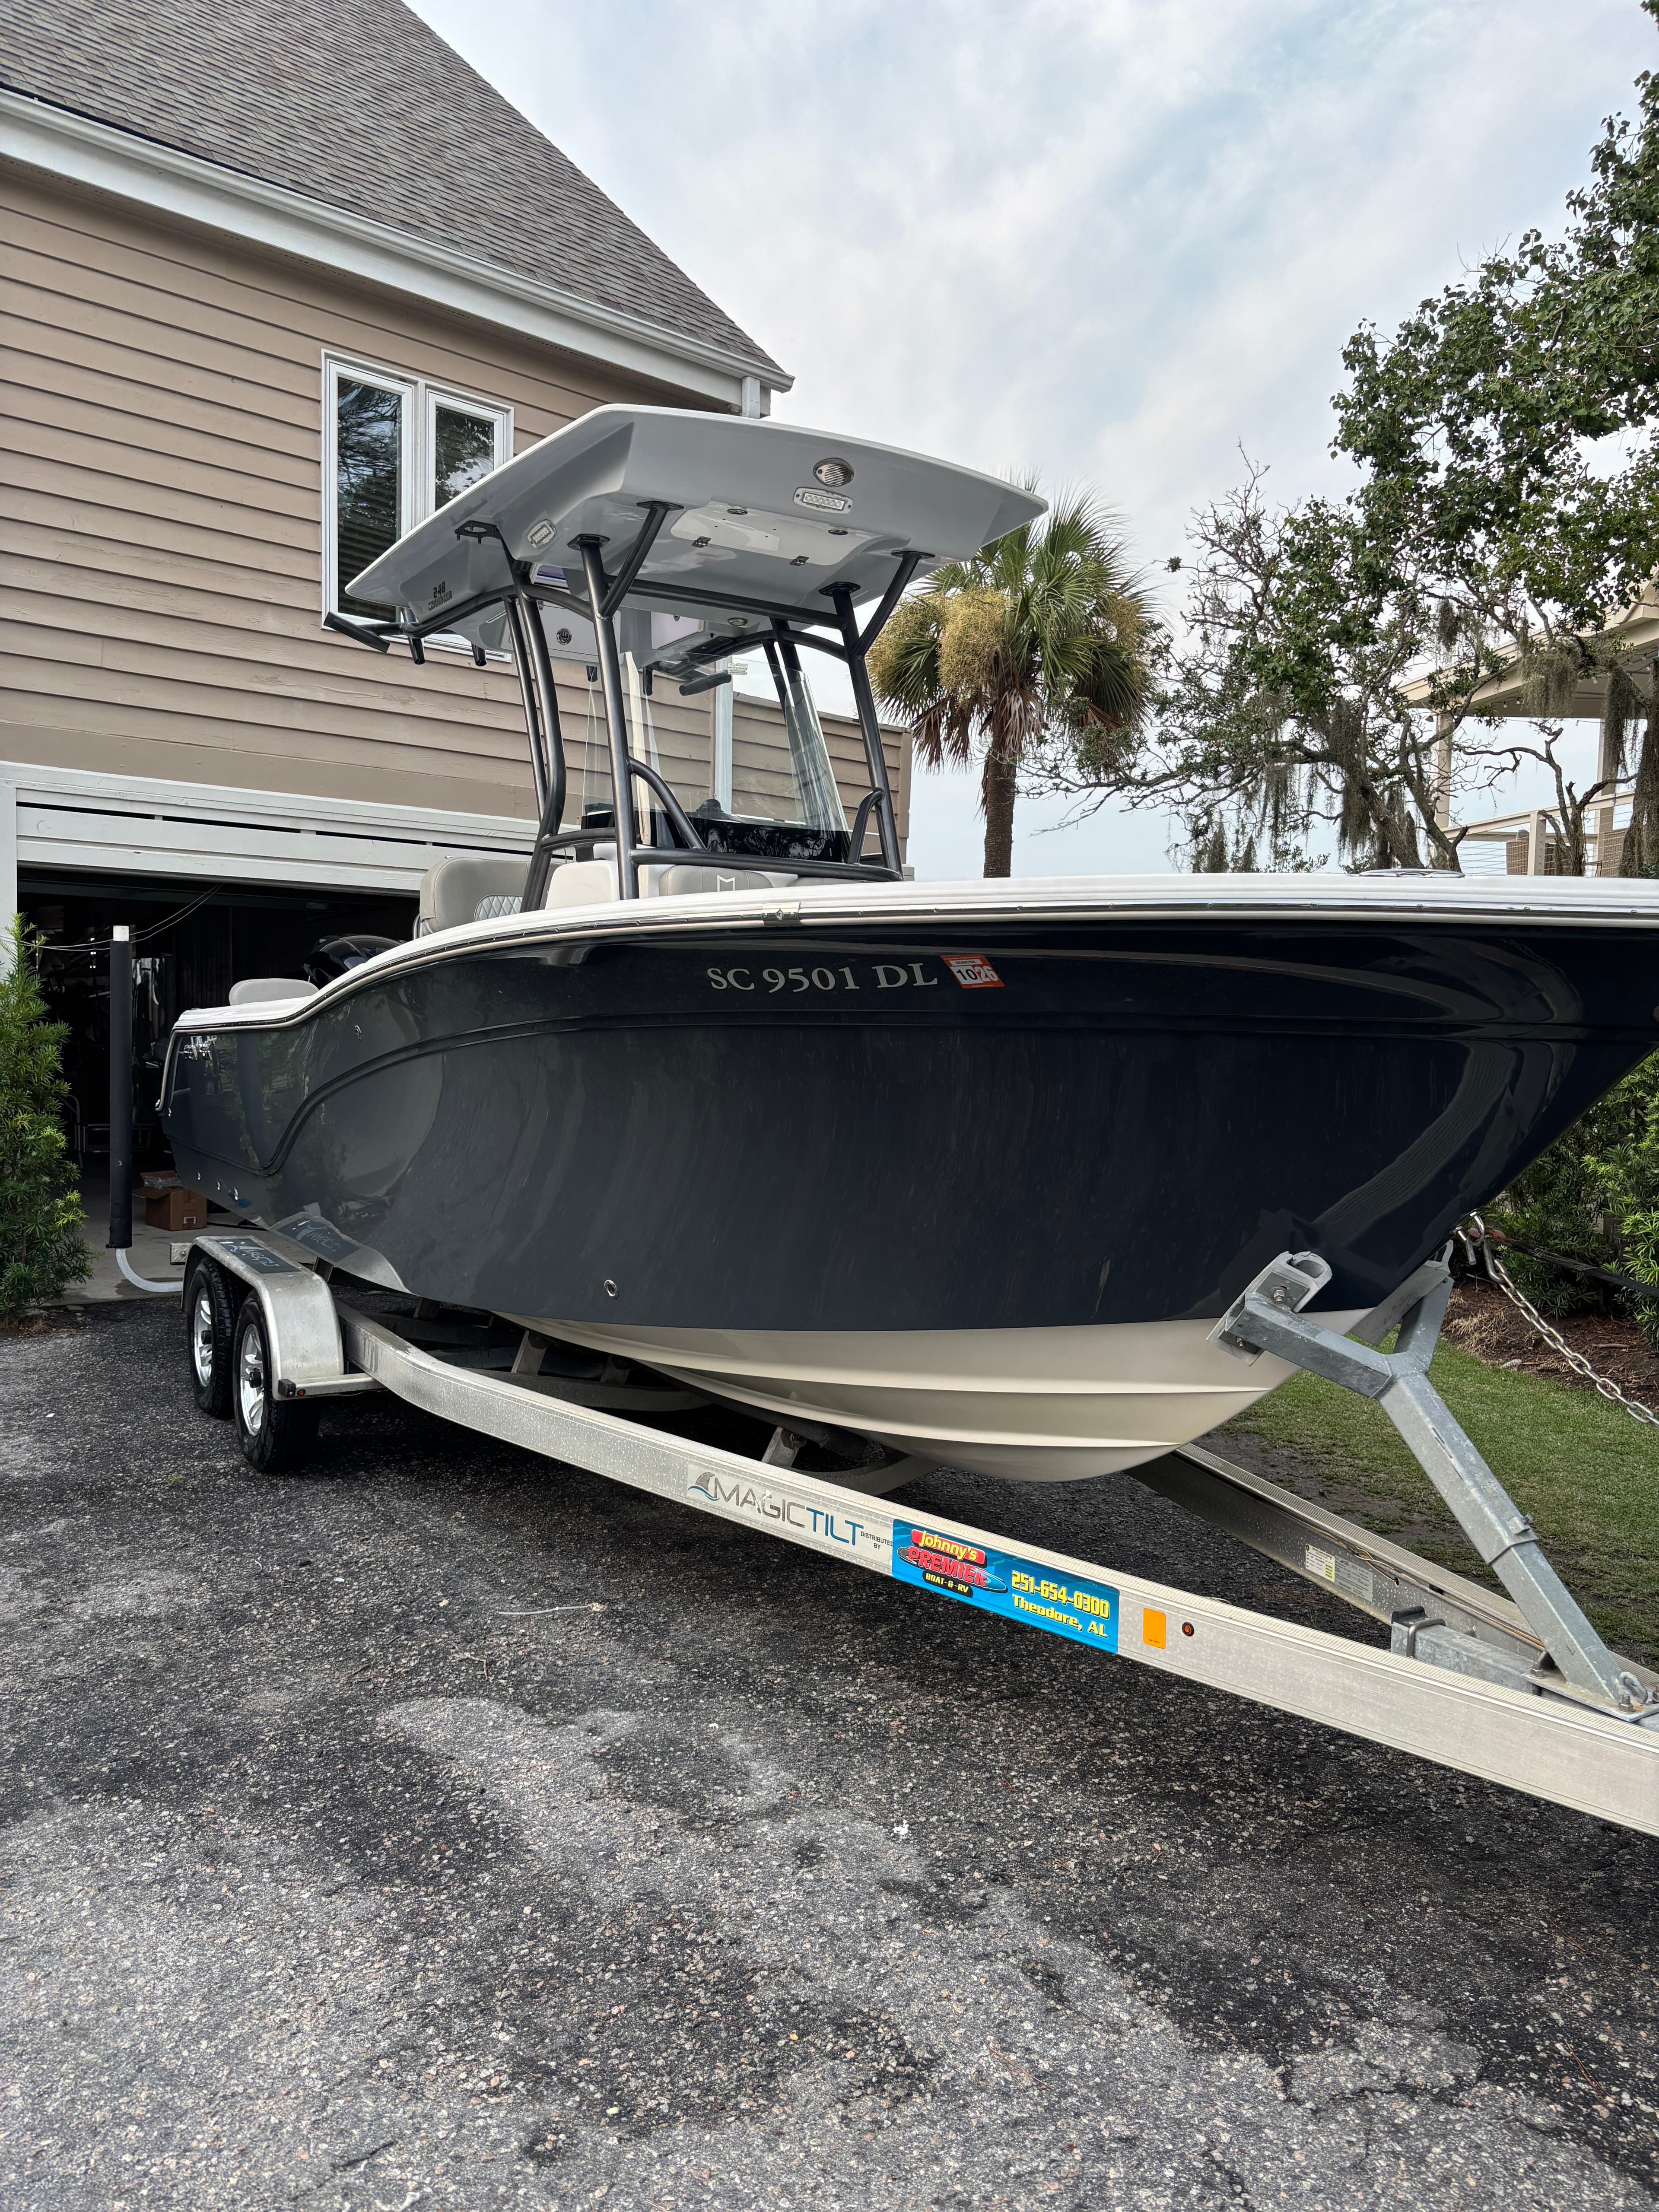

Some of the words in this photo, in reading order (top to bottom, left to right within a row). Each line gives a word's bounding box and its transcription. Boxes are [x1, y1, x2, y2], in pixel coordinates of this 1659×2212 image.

[433, 581, 445, 598] 248
[707, 968, 755, 990] SC
[763, 967, 860, 993] 9501
[872, 963, 938, 988] DL
[956, 969, 978, 980] 10
[974, 966, 998, 982] 26
[918, 1531, 977, 1561] Johnny's
[908, 1545, 987, 1587] PREMIER
[1012, 1570, 1110, 1619] 251-654-0300
[1012, 1595, 1083, 1631] Theodore,
[1088, 1621, 1108, 1638] AL
